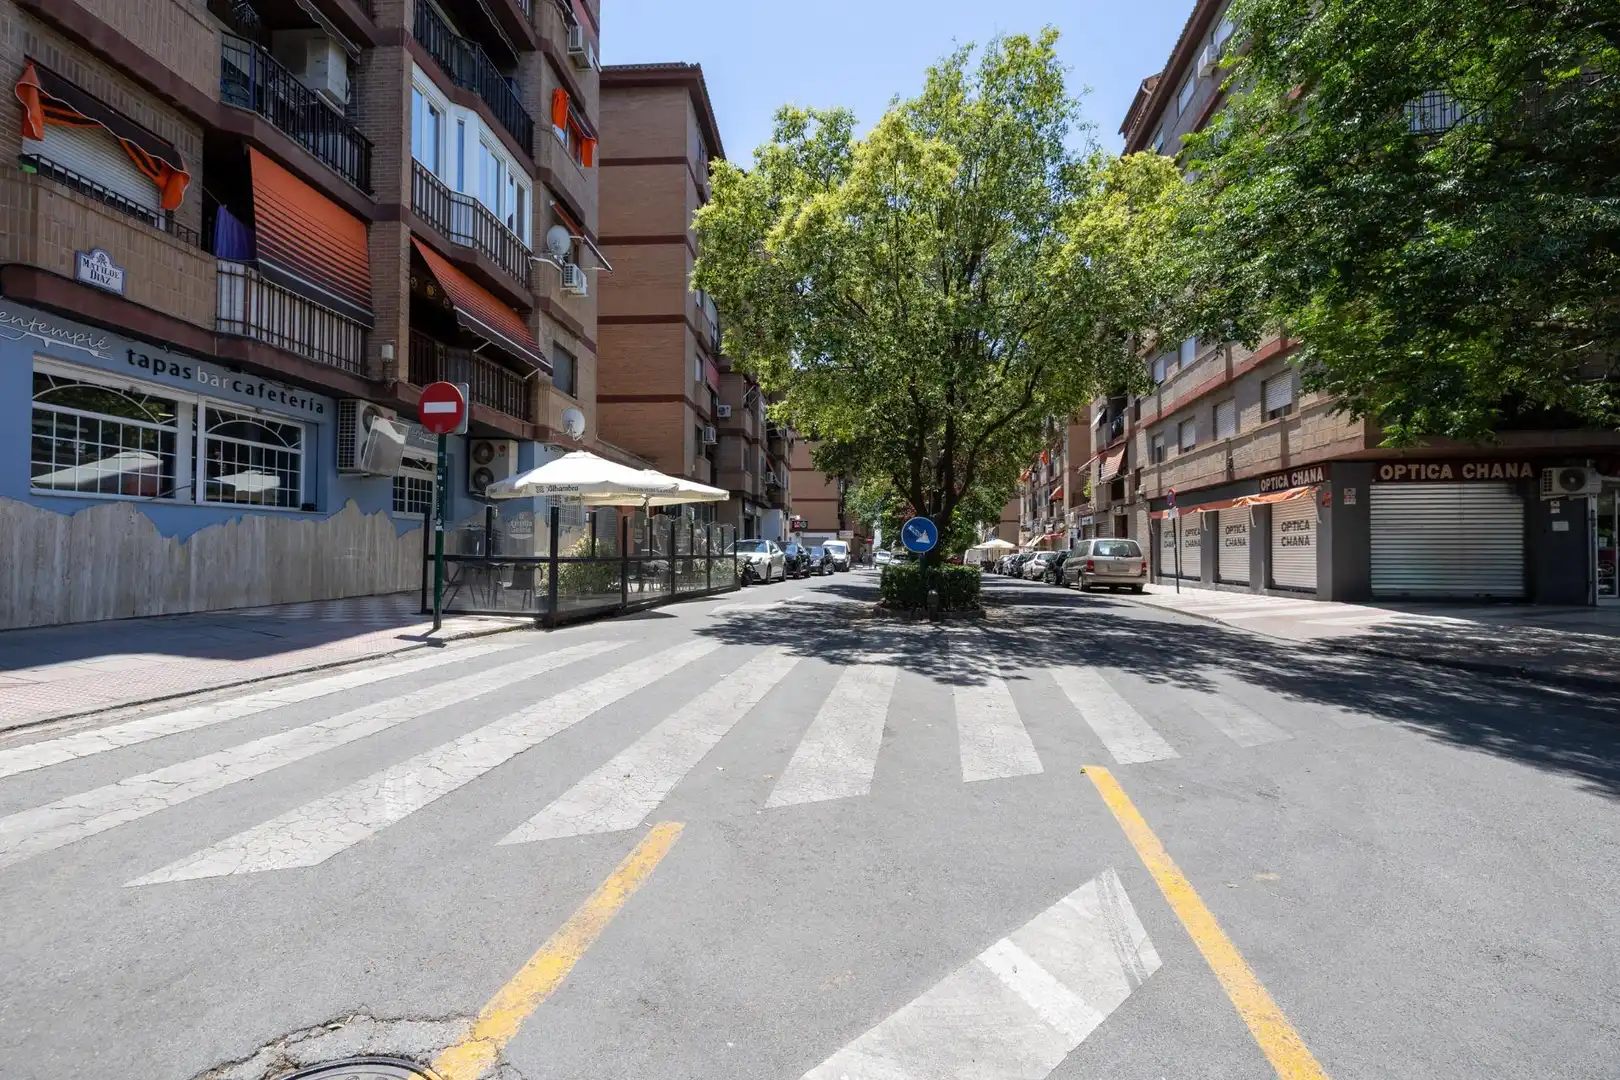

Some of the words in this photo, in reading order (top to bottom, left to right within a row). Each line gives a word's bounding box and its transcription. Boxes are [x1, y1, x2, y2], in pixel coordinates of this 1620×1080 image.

[82, 257, 120, 280] MATILDE
[126, 348, 192, 380] tapas
[196, 365, 229, 389] bar
[1380, 463, 1453, 480] OPTICA
[1462, 462, 1533, 479] CHANA
[1260, 473, 1289, 491] OPTICA
[1291, 467, 1324, 486] CHANA
[546, 484, 579, 493] Alhambra
[1225, 524, 1246, 534] OPTICA
[1281, 520, 1310, 532] OPTICA
[1225, 537, 1247, 547] CHANA
[1281, 535, 1310, 546] CHANA
